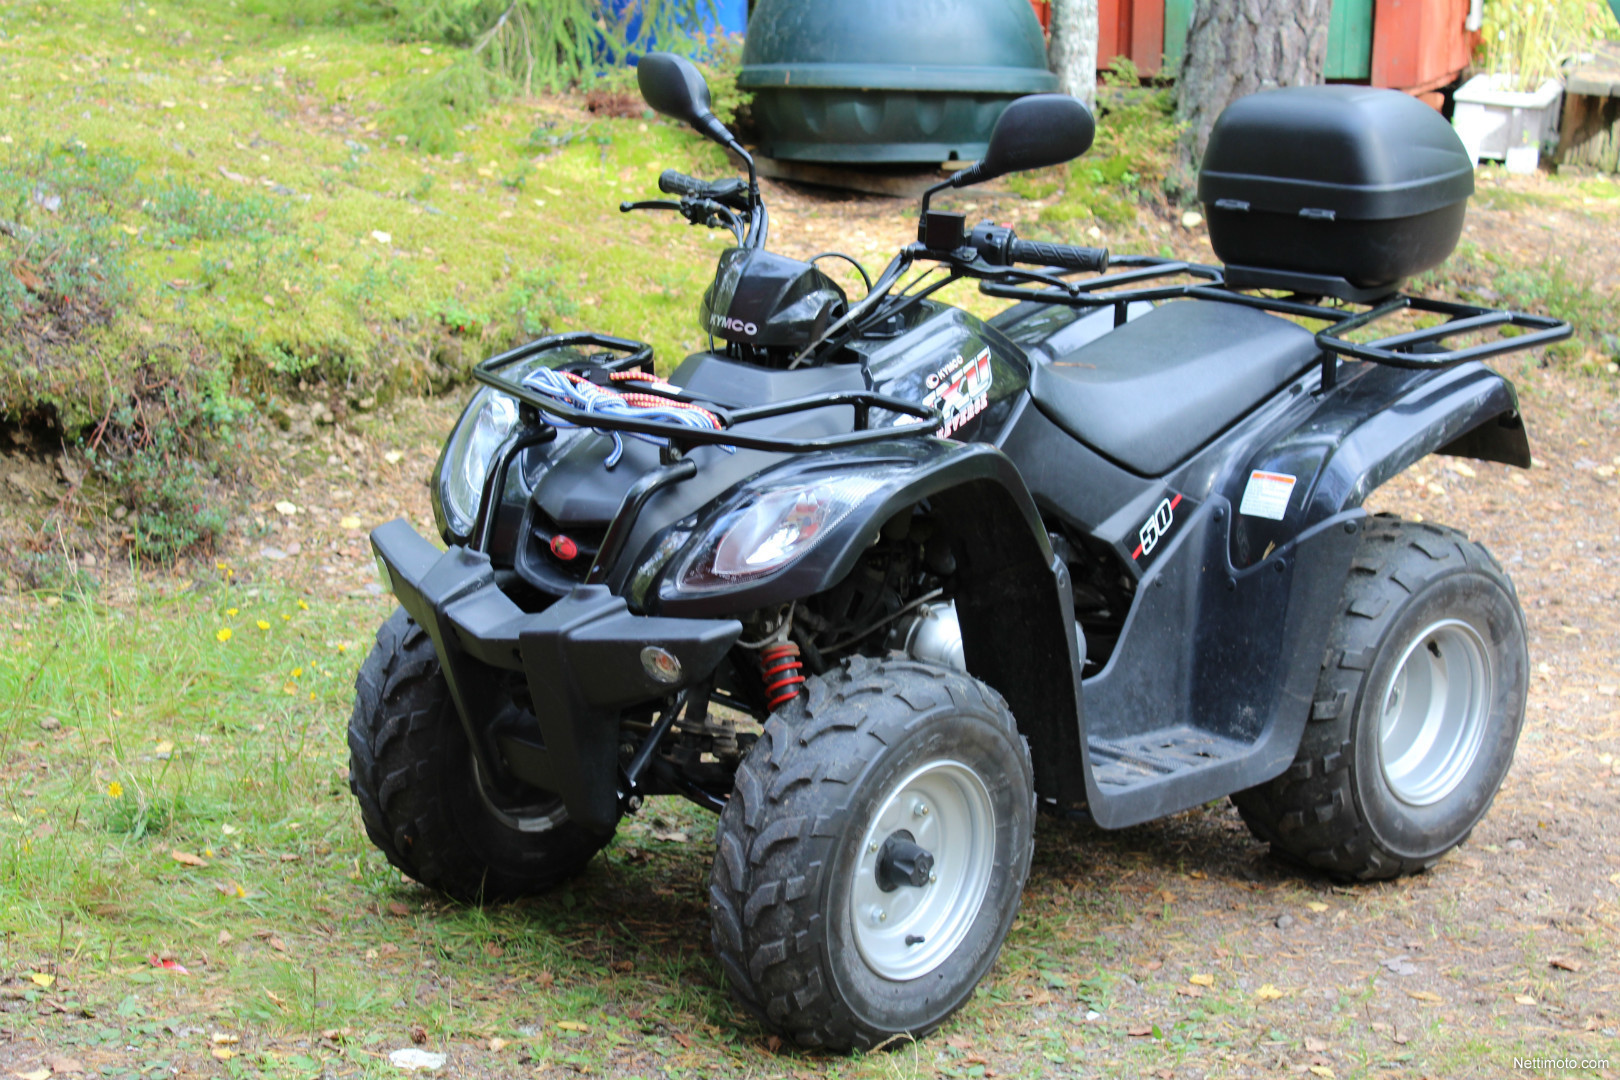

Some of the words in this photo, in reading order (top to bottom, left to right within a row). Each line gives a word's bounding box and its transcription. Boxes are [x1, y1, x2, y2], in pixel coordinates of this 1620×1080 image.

[710, 313, 758, 336] KYMCO
[937, 354, 964, 380] KYMCO
[1139, 498, 1173, 556] 50
